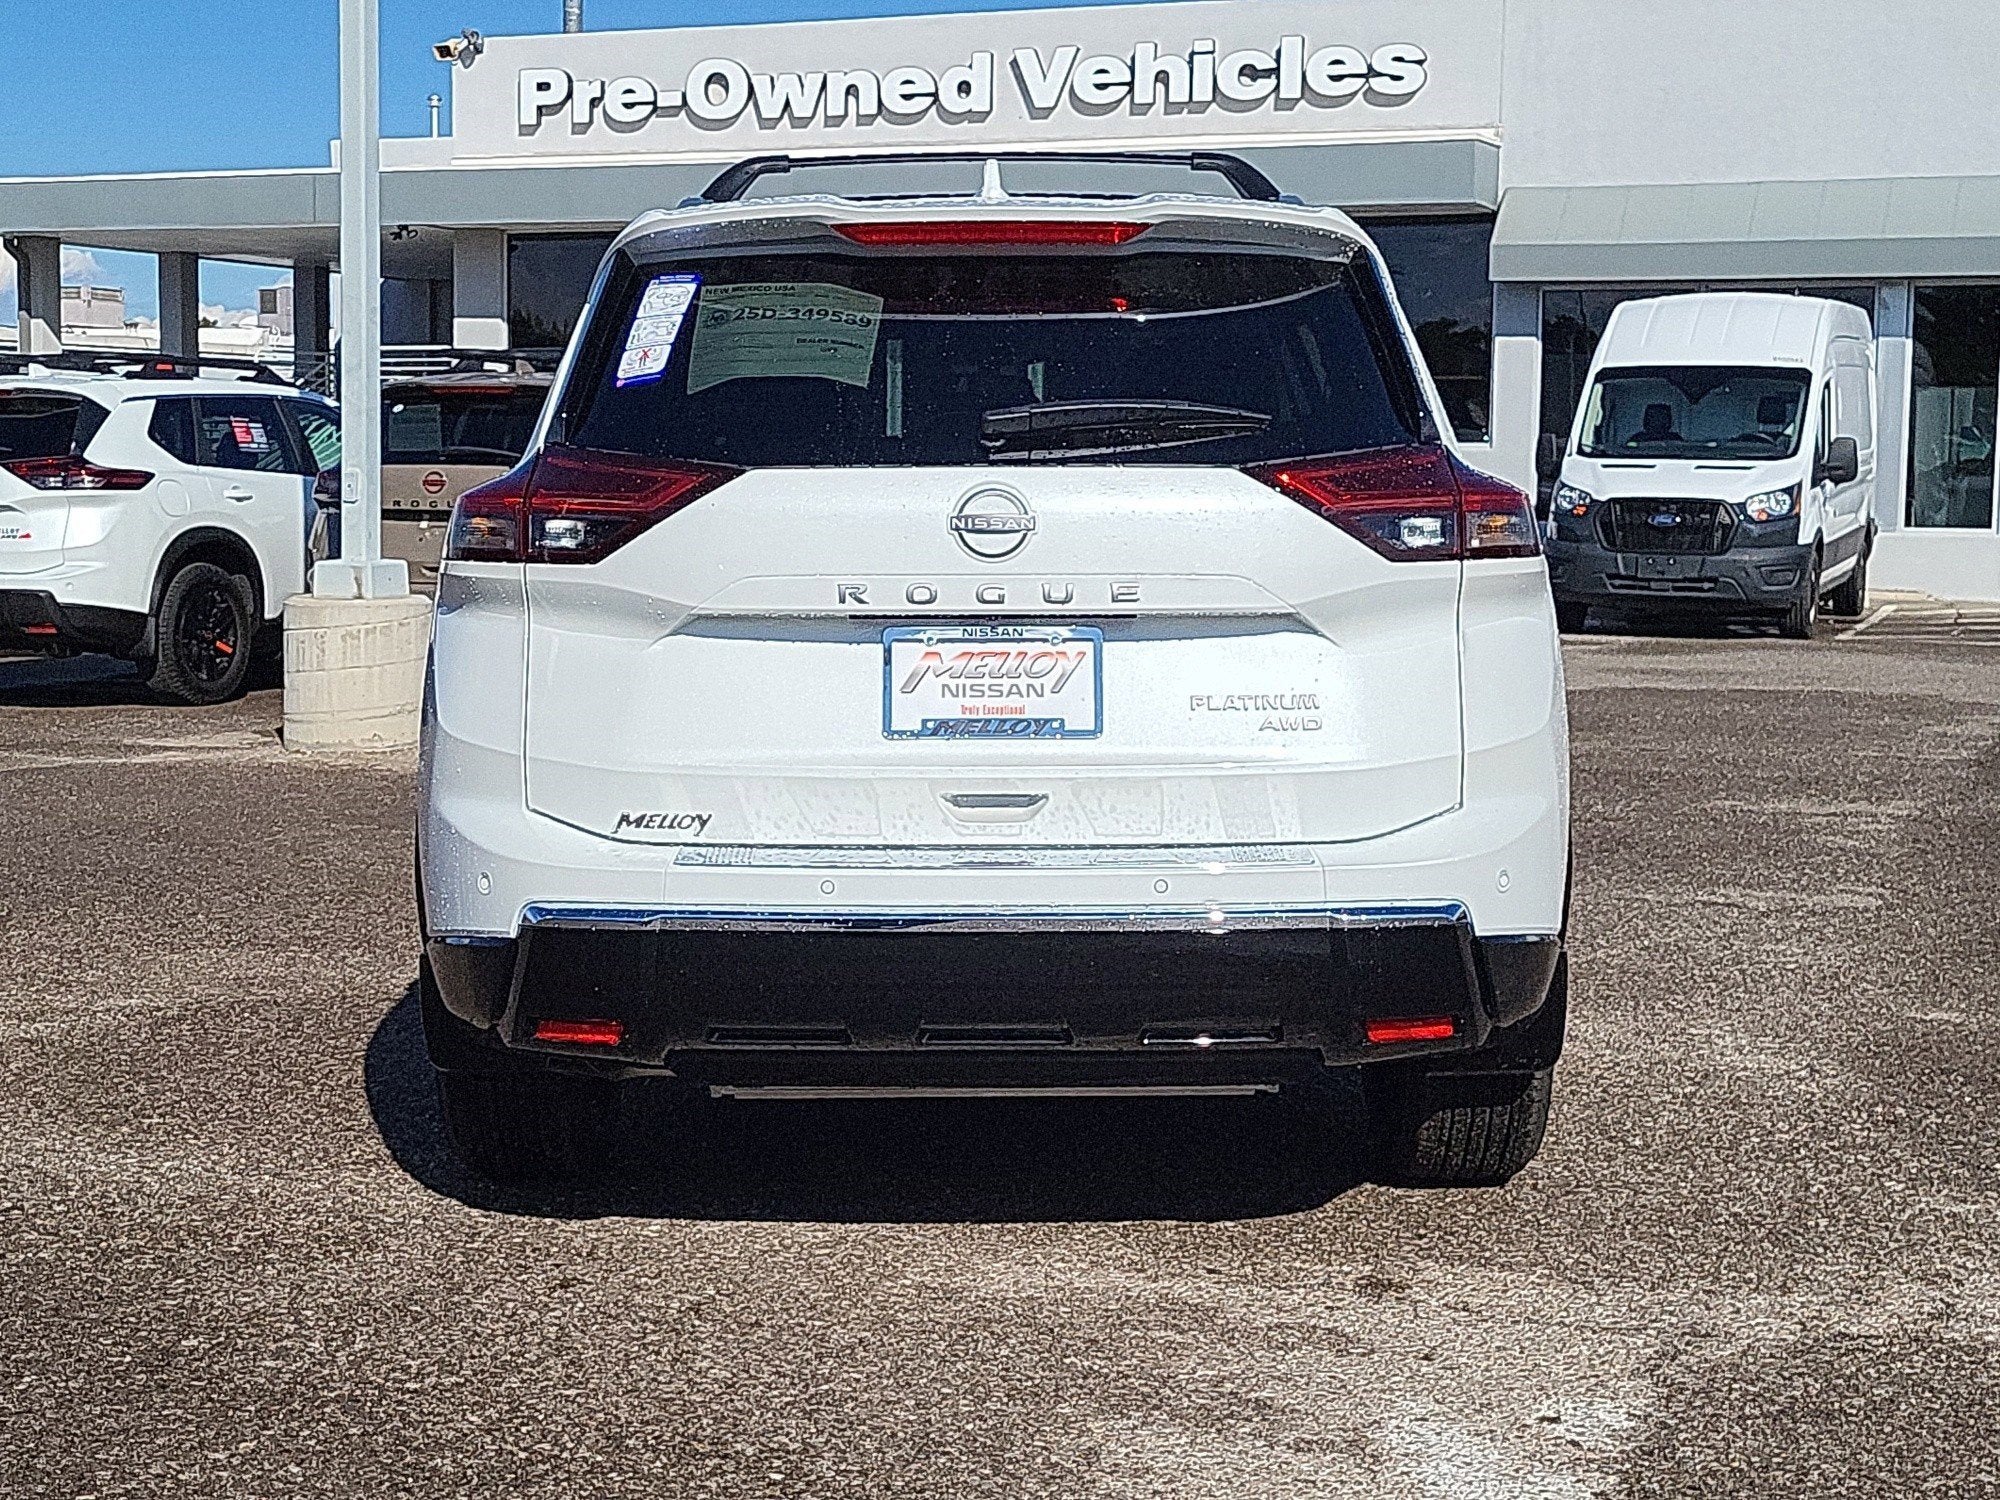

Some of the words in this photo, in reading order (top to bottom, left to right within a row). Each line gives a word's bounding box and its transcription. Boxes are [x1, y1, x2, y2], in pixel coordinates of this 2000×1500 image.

[516, 50, 993, 137] Pre-Owned
[1009, 35, 1428, 120] Vehicles
[704, 287, 730, 296] NEW
[731, 285, 772, 293] MEXICO
[774, 284, 796, 293] USA
[951, 515, 1035, 532] NISSAN
[837, 582, 1140, 606] ROGUE
[961, 628, 1025, 638] NISSAN
[899, 650, 1087, 694] MELLOY
[941, 683, 1045, 699] NISSAN
[1189, 694, 1321, 712] PLATINUM
[930, 719, 1049, 737] MELLOY
[1258, 715, 1322, 732] AWD
[610, 811, 712, 837] MELLOY
